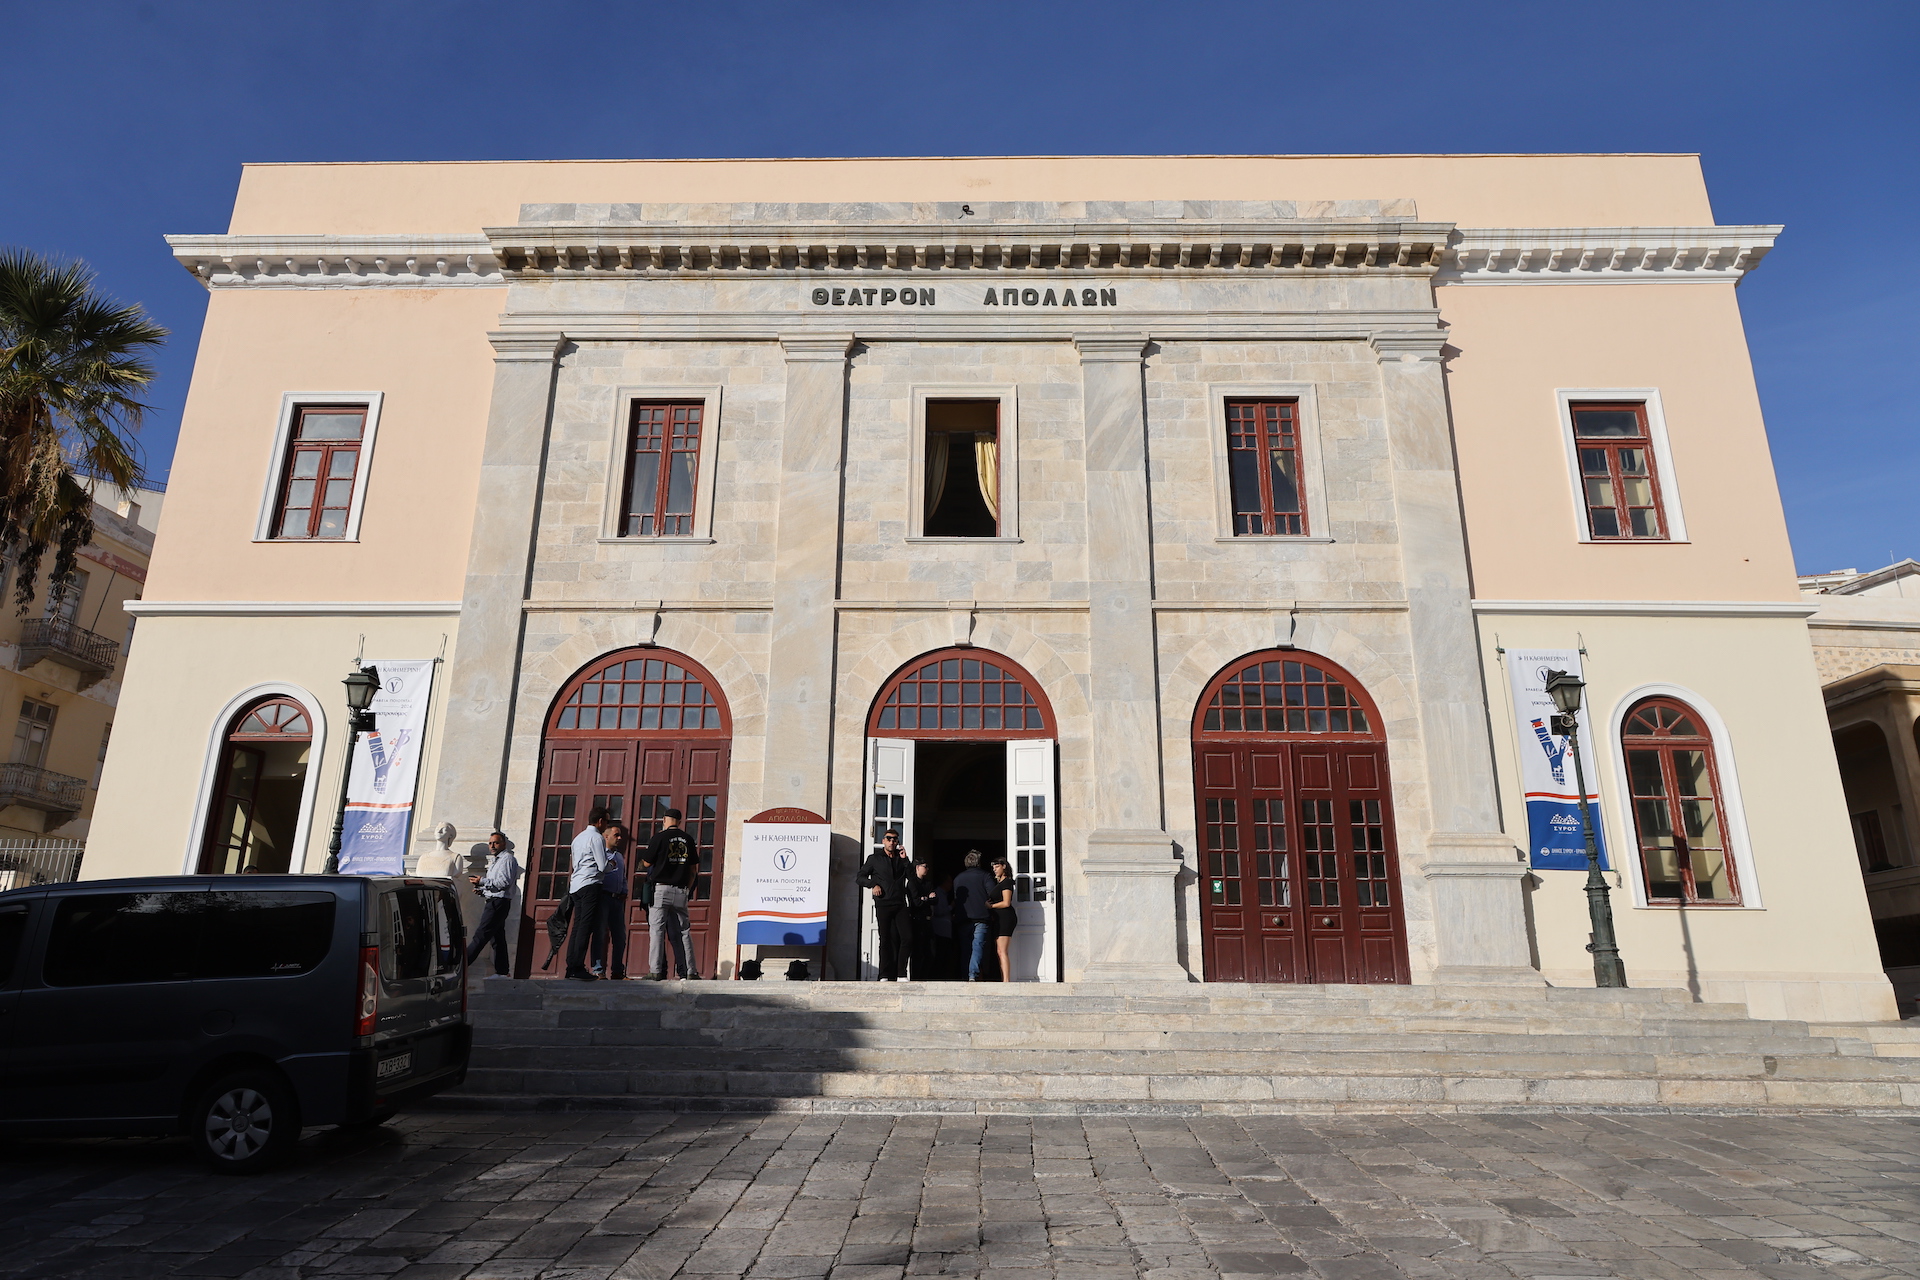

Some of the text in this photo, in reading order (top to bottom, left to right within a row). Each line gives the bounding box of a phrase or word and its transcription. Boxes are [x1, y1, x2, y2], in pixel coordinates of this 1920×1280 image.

[811, 287, 1117, 306] ΘΕΑΤΡΟΝ ΑΠΟΛΛΩΝ
[768, 834, 819, 842] ΚΑΘΗΜΕΡΙΝΗ
[760, 894, 806, 904] γαστρονόμος
